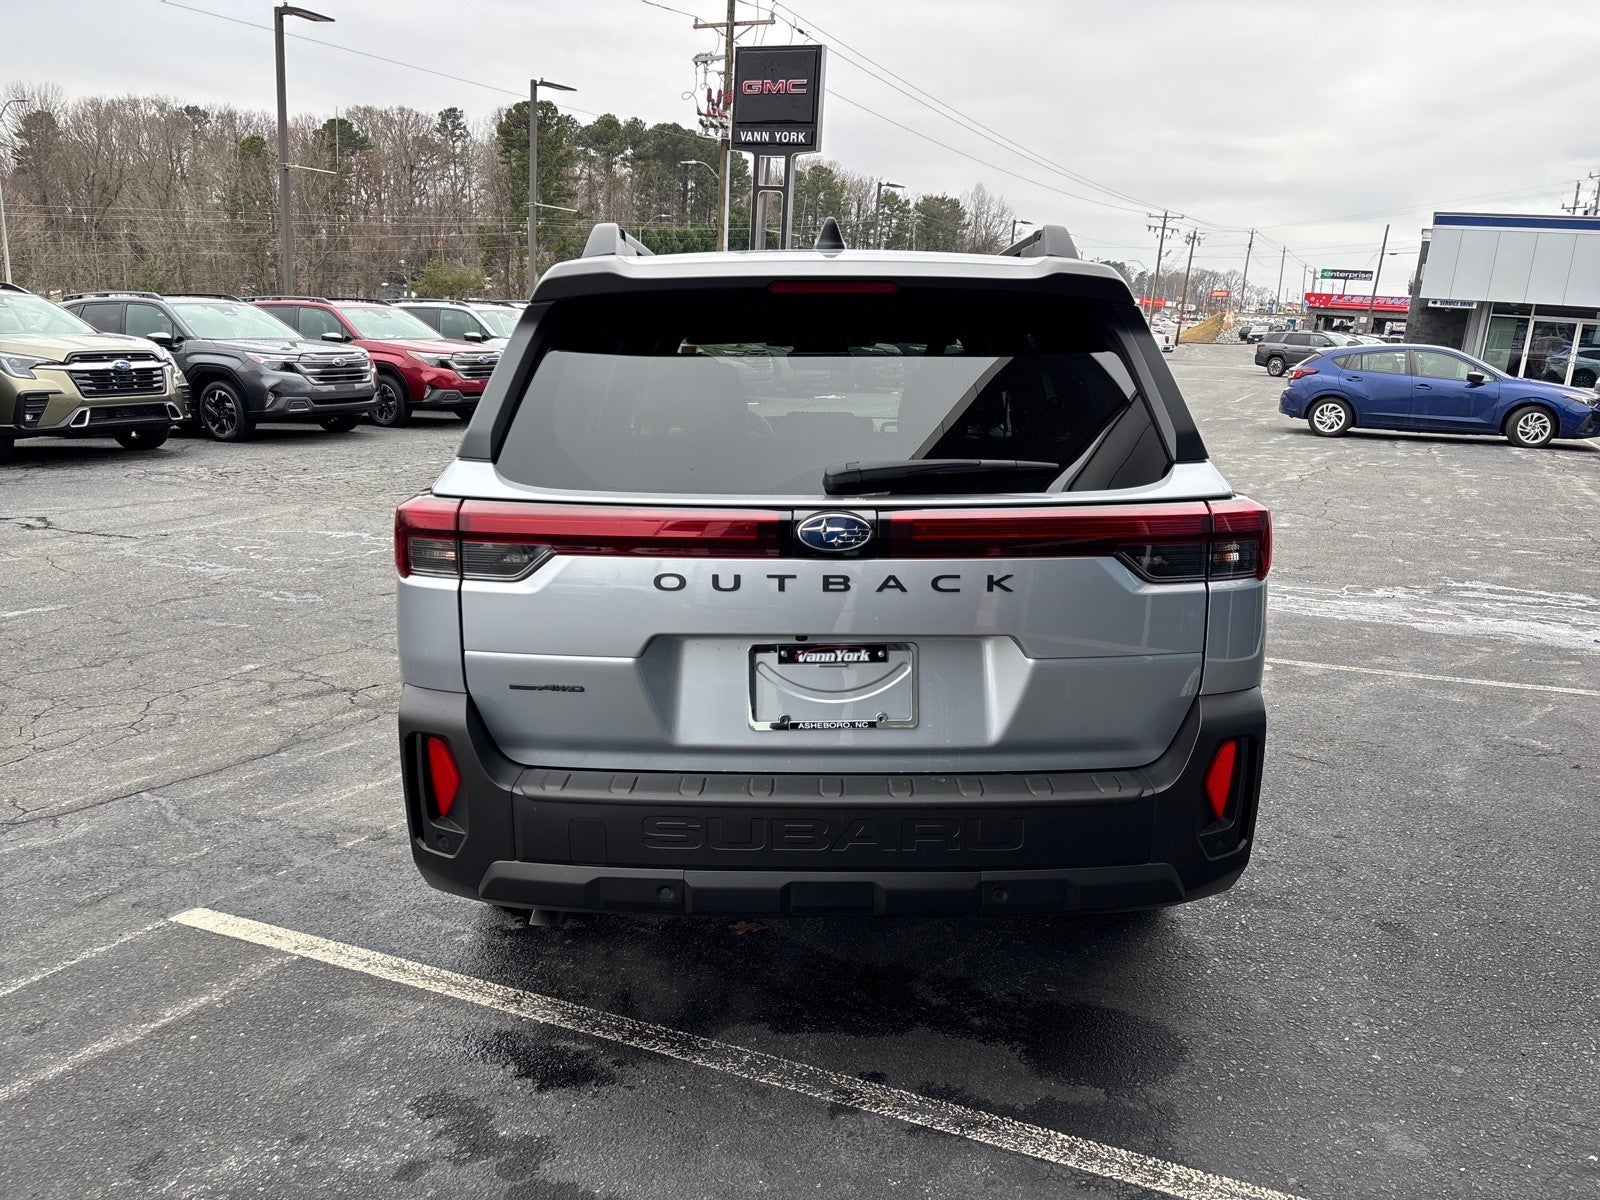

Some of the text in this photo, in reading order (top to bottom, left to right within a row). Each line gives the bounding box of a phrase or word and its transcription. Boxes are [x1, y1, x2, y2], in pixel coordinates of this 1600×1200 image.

[742, 79, 808, 95] GMC
[740, 131, 806, 143] VANN YORK
[1322, 271, 1372, 280] enterprise
[653, 573, 1015, 593] OUTBACK
[798, 721, 869, 730] ASHEBORO, NC
[642, 815, 1026, 852] SUBARU
